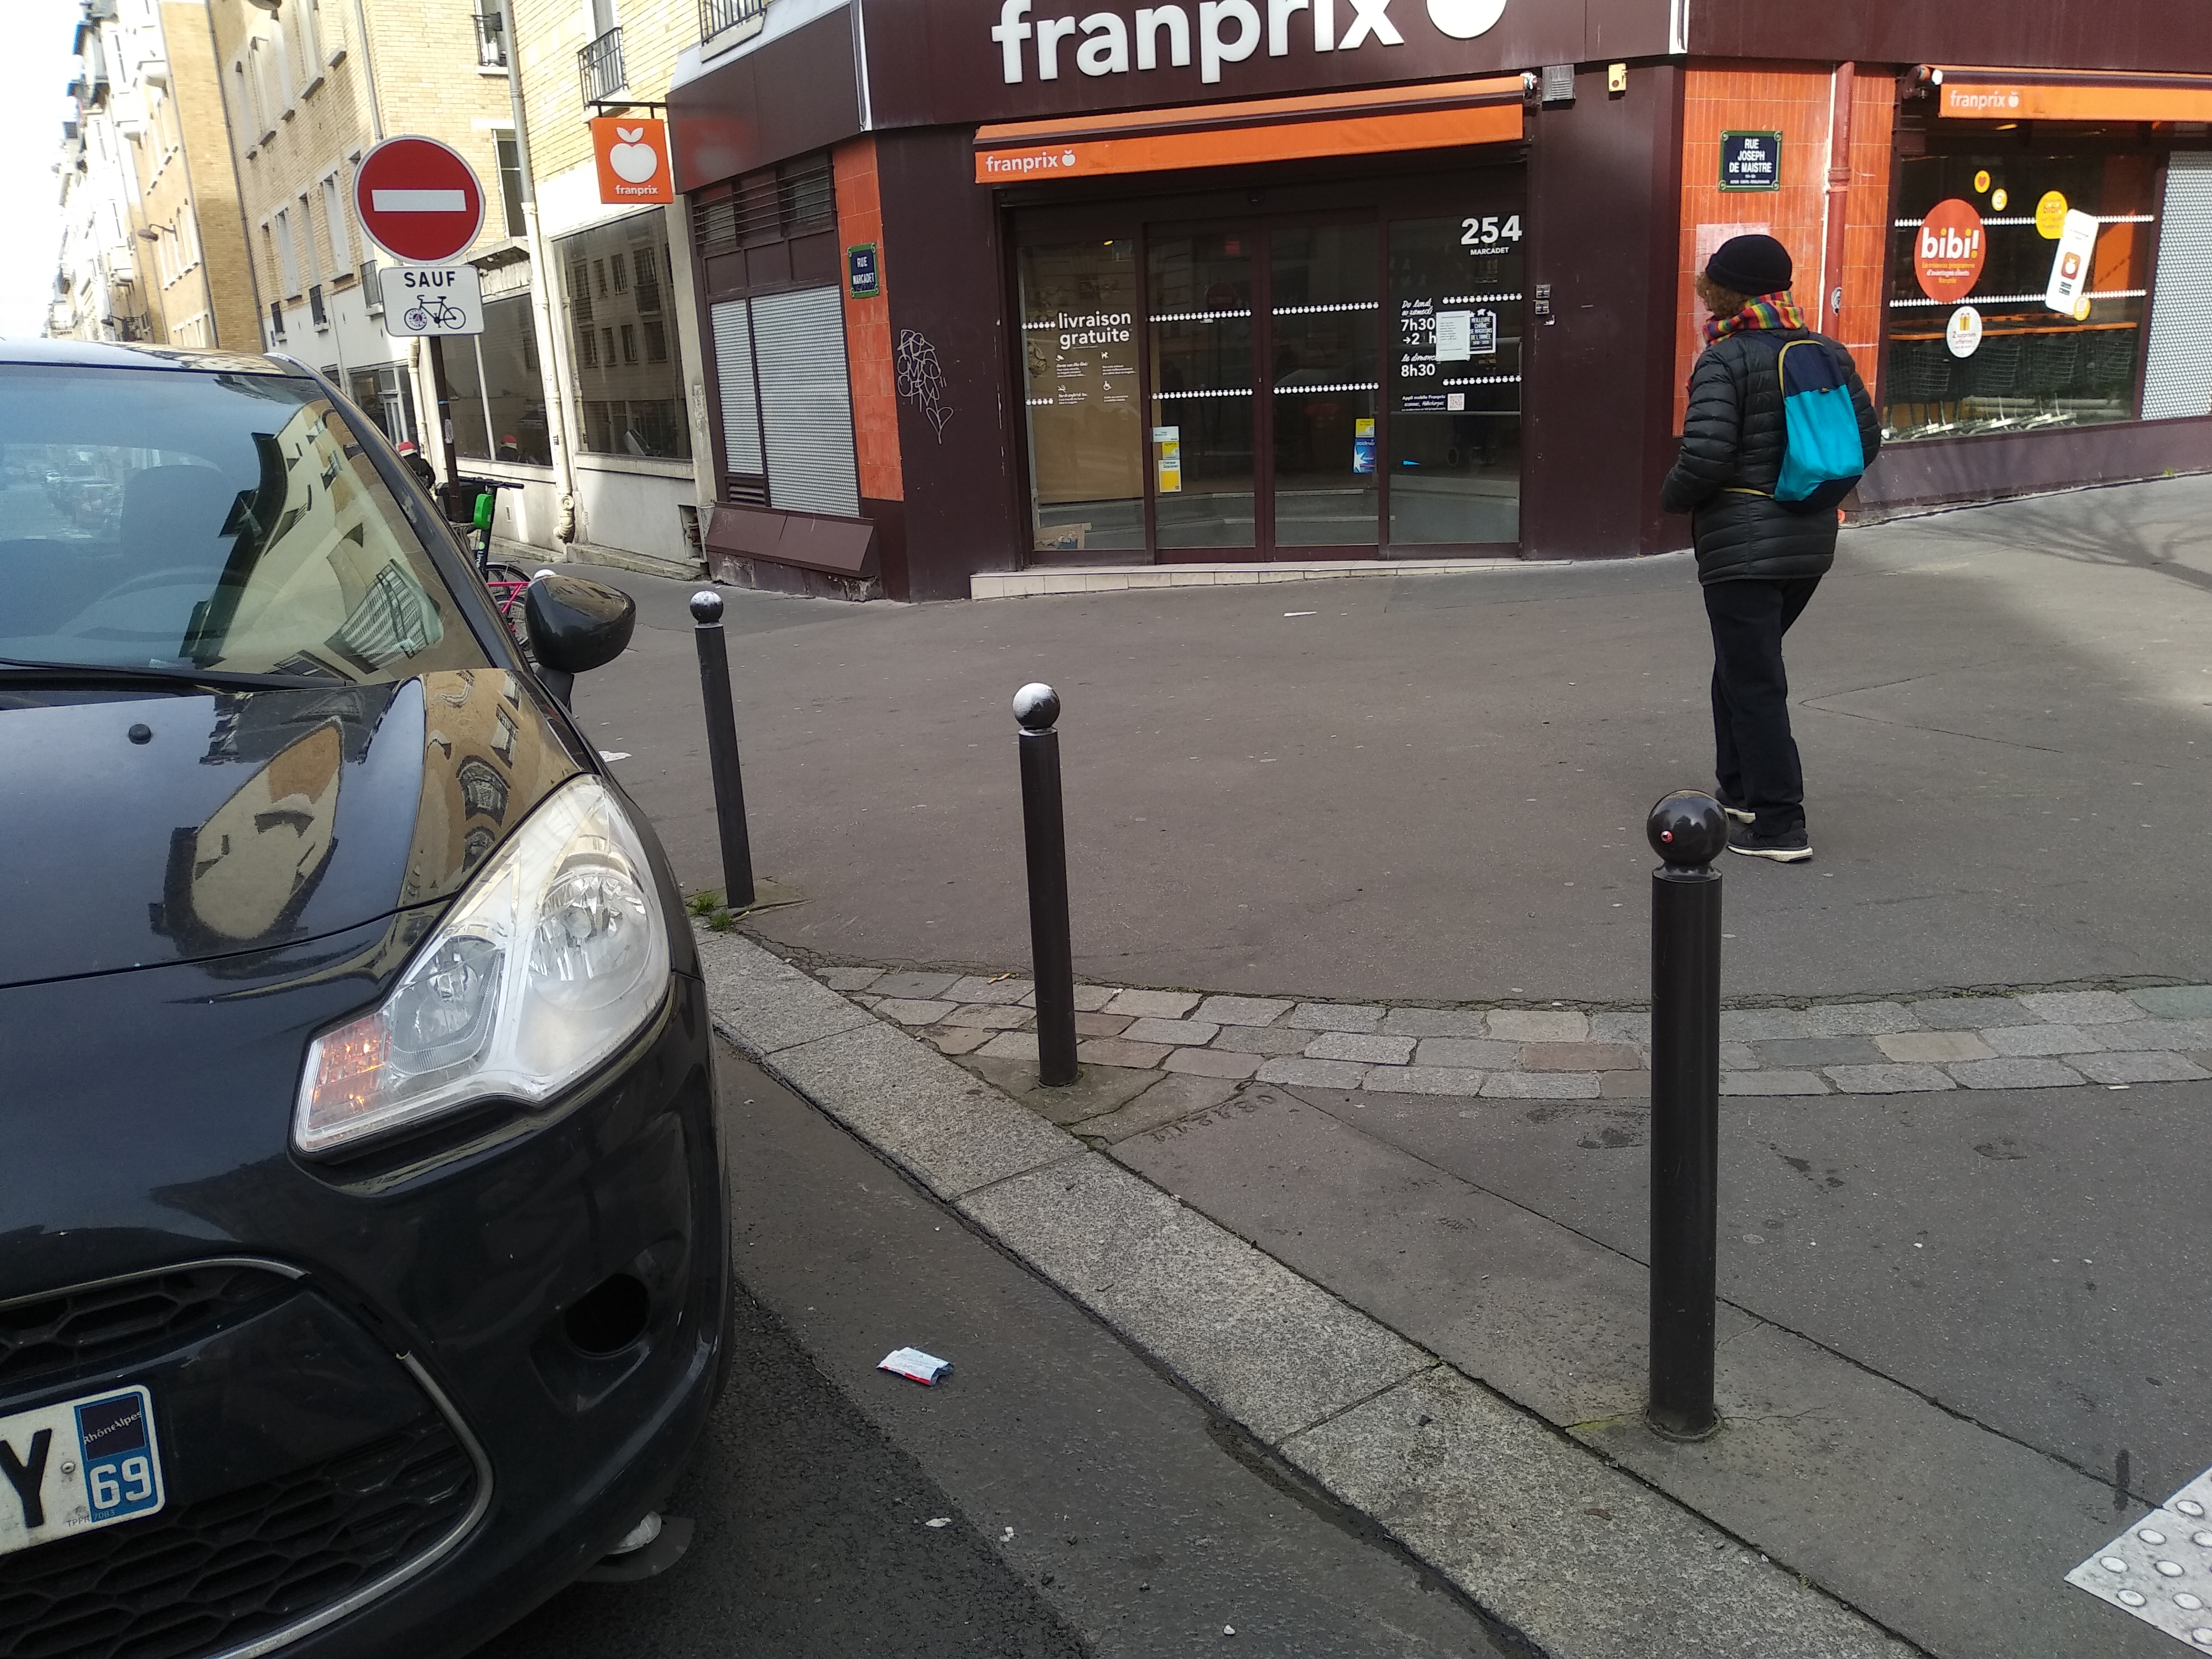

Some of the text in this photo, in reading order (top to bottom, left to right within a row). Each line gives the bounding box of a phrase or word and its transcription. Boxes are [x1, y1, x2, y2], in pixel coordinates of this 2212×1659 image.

[992, 0, 1405, 84] franprix
[1950, 90, 2006, 111] franprix
[1744, 138, 1760, 149] RUE
[985, 151, 1059, 173] franprix
[1738, 150, 1765, 161] JOSEPH
[1729, 162, 1772, 173] DE MAISTRE
[615, 184, 659, 197] franprix
[1461, 215, 1523, 245] 254
[1921, 227, 1980, 259] bibi!
[1470, 247, 1510, 255] MARCADET
[857, 256, 868, 268] RUE
[404, 271, 456, 288] SAUF
[852, 272, 875, 285] MARCADET
[1413, 298, 1432, 308] lundi
[1409, 307, 1433, 316] samedi
[1058, 311, 1131, 329] livraison
[1400, 317, 1436, 332] 7h30
[1411, 352, 1444, 362] dimanche
[1400, 363, 1436, 377] 8h30
[475, 551, 484, 568] Lime
[0, 1428, 53, 1528] Y
[89, 1456, 152, 1510] 69
